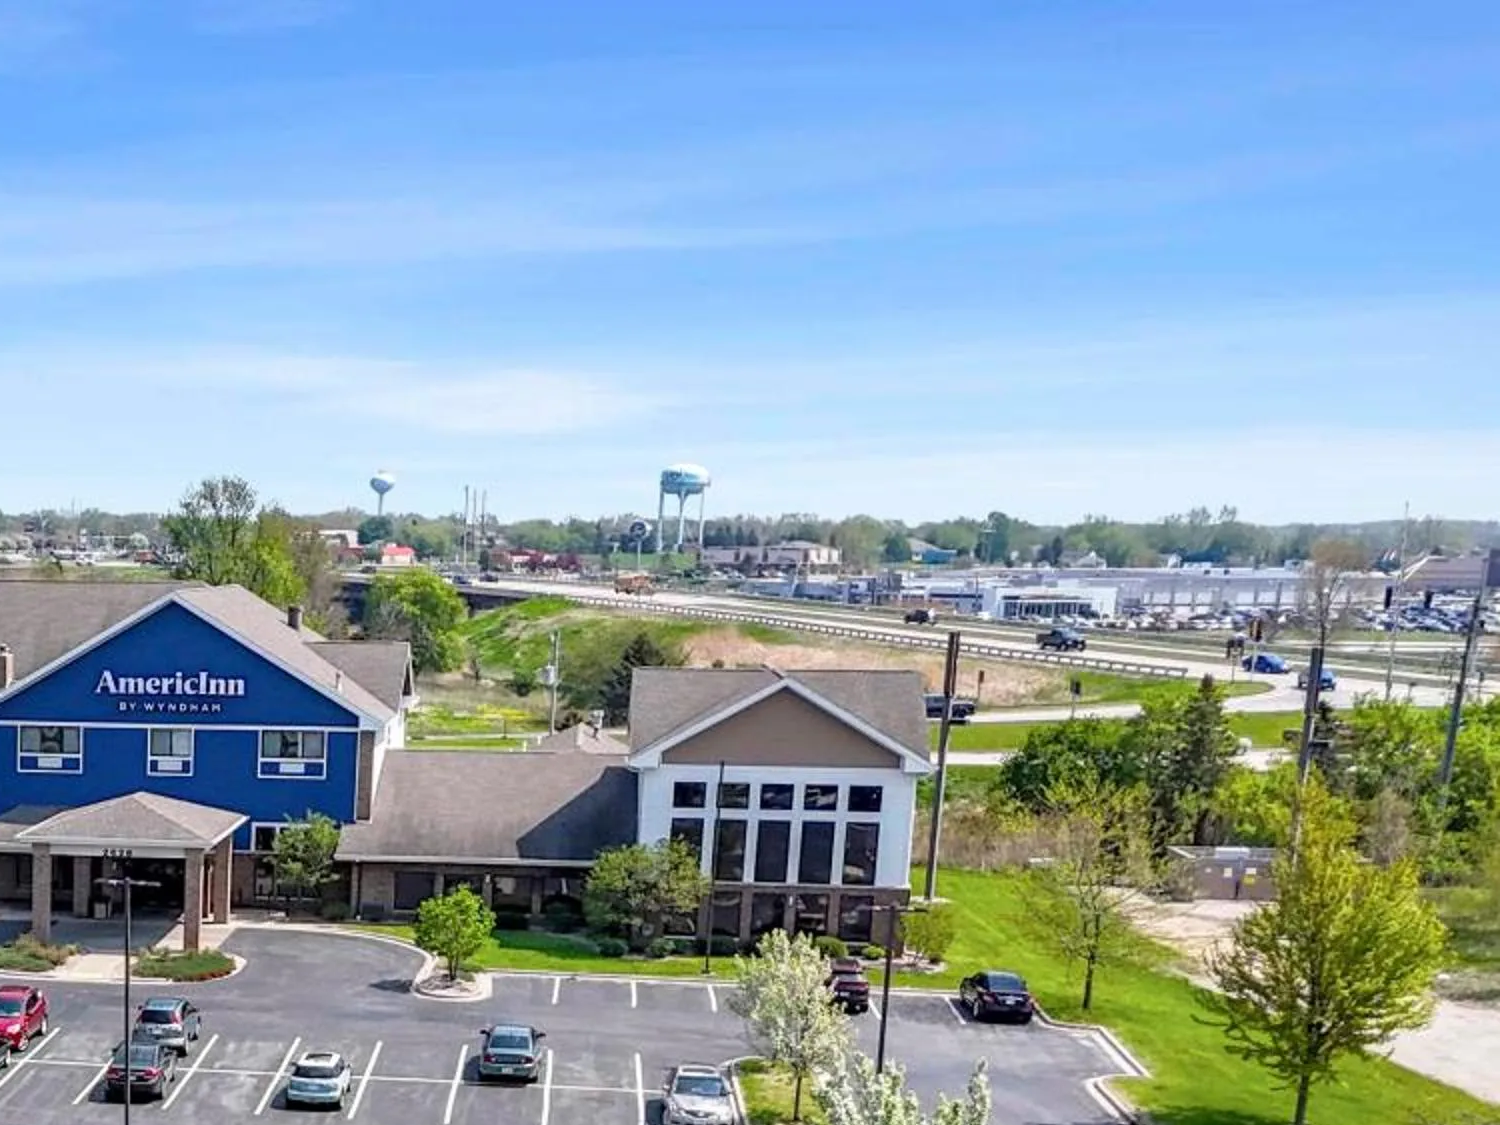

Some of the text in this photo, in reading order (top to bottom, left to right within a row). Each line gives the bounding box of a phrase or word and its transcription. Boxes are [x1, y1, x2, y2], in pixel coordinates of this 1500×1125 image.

[95, 670, 245, 696] AmericInn
[119, 702, 221, 713] BY WYNDHAM
